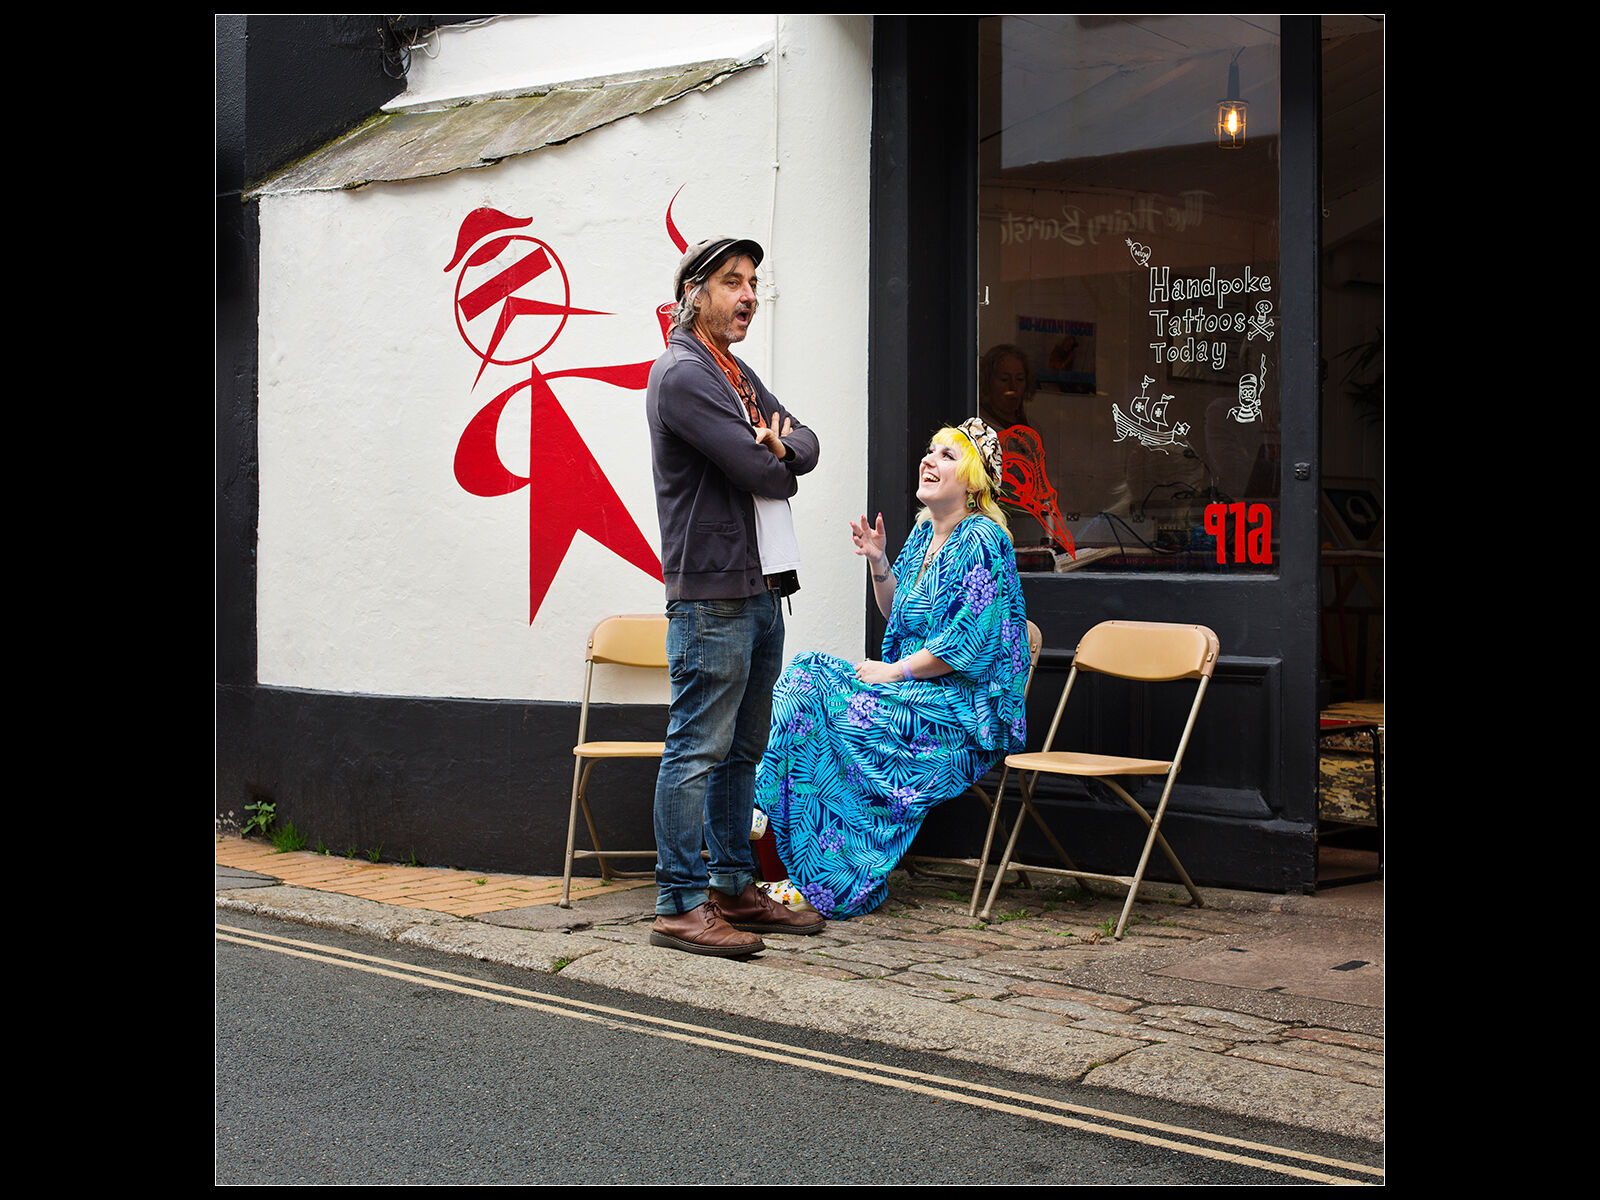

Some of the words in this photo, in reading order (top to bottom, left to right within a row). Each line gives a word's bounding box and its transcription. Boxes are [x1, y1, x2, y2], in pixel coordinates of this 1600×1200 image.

[1149, 266, 1272, 308] Handpoke
[1149, 309, 1245, 336] Tattoos
[1150, 339, 1226, 370] Today
